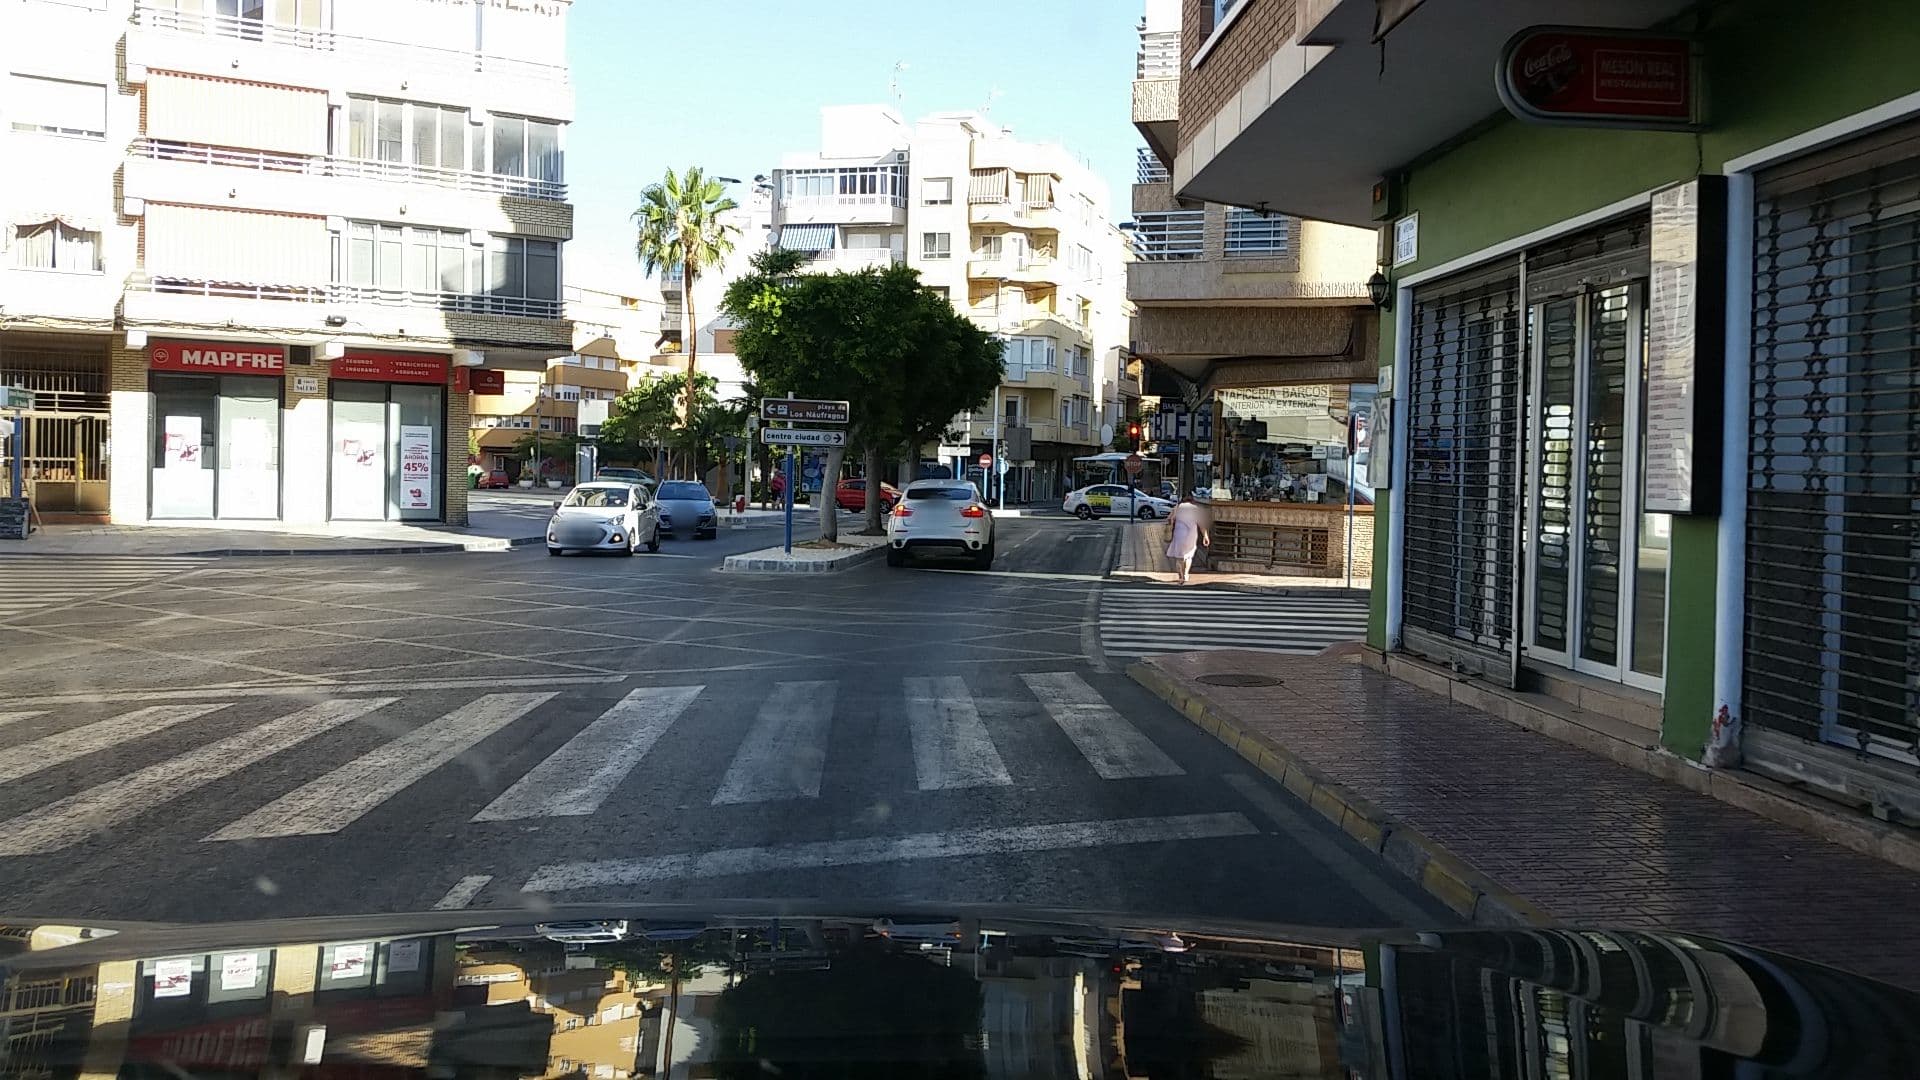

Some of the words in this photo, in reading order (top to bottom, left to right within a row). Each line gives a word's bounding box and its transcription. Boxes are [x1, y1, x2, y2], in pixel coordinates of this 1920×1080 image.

[1524, 43, 1572, 78] Coca-Cola
[182, 350, 283, 369] MAPFRE
[1282, 386, 1328, 399] BARCOS
[1231, 401, 1264, 410] INTERIOR
[1276, 399, 1317, 409] EXTERIOR
[795, 433, 820, 441] ciudad
[404, 463, 429, 472] 45%
